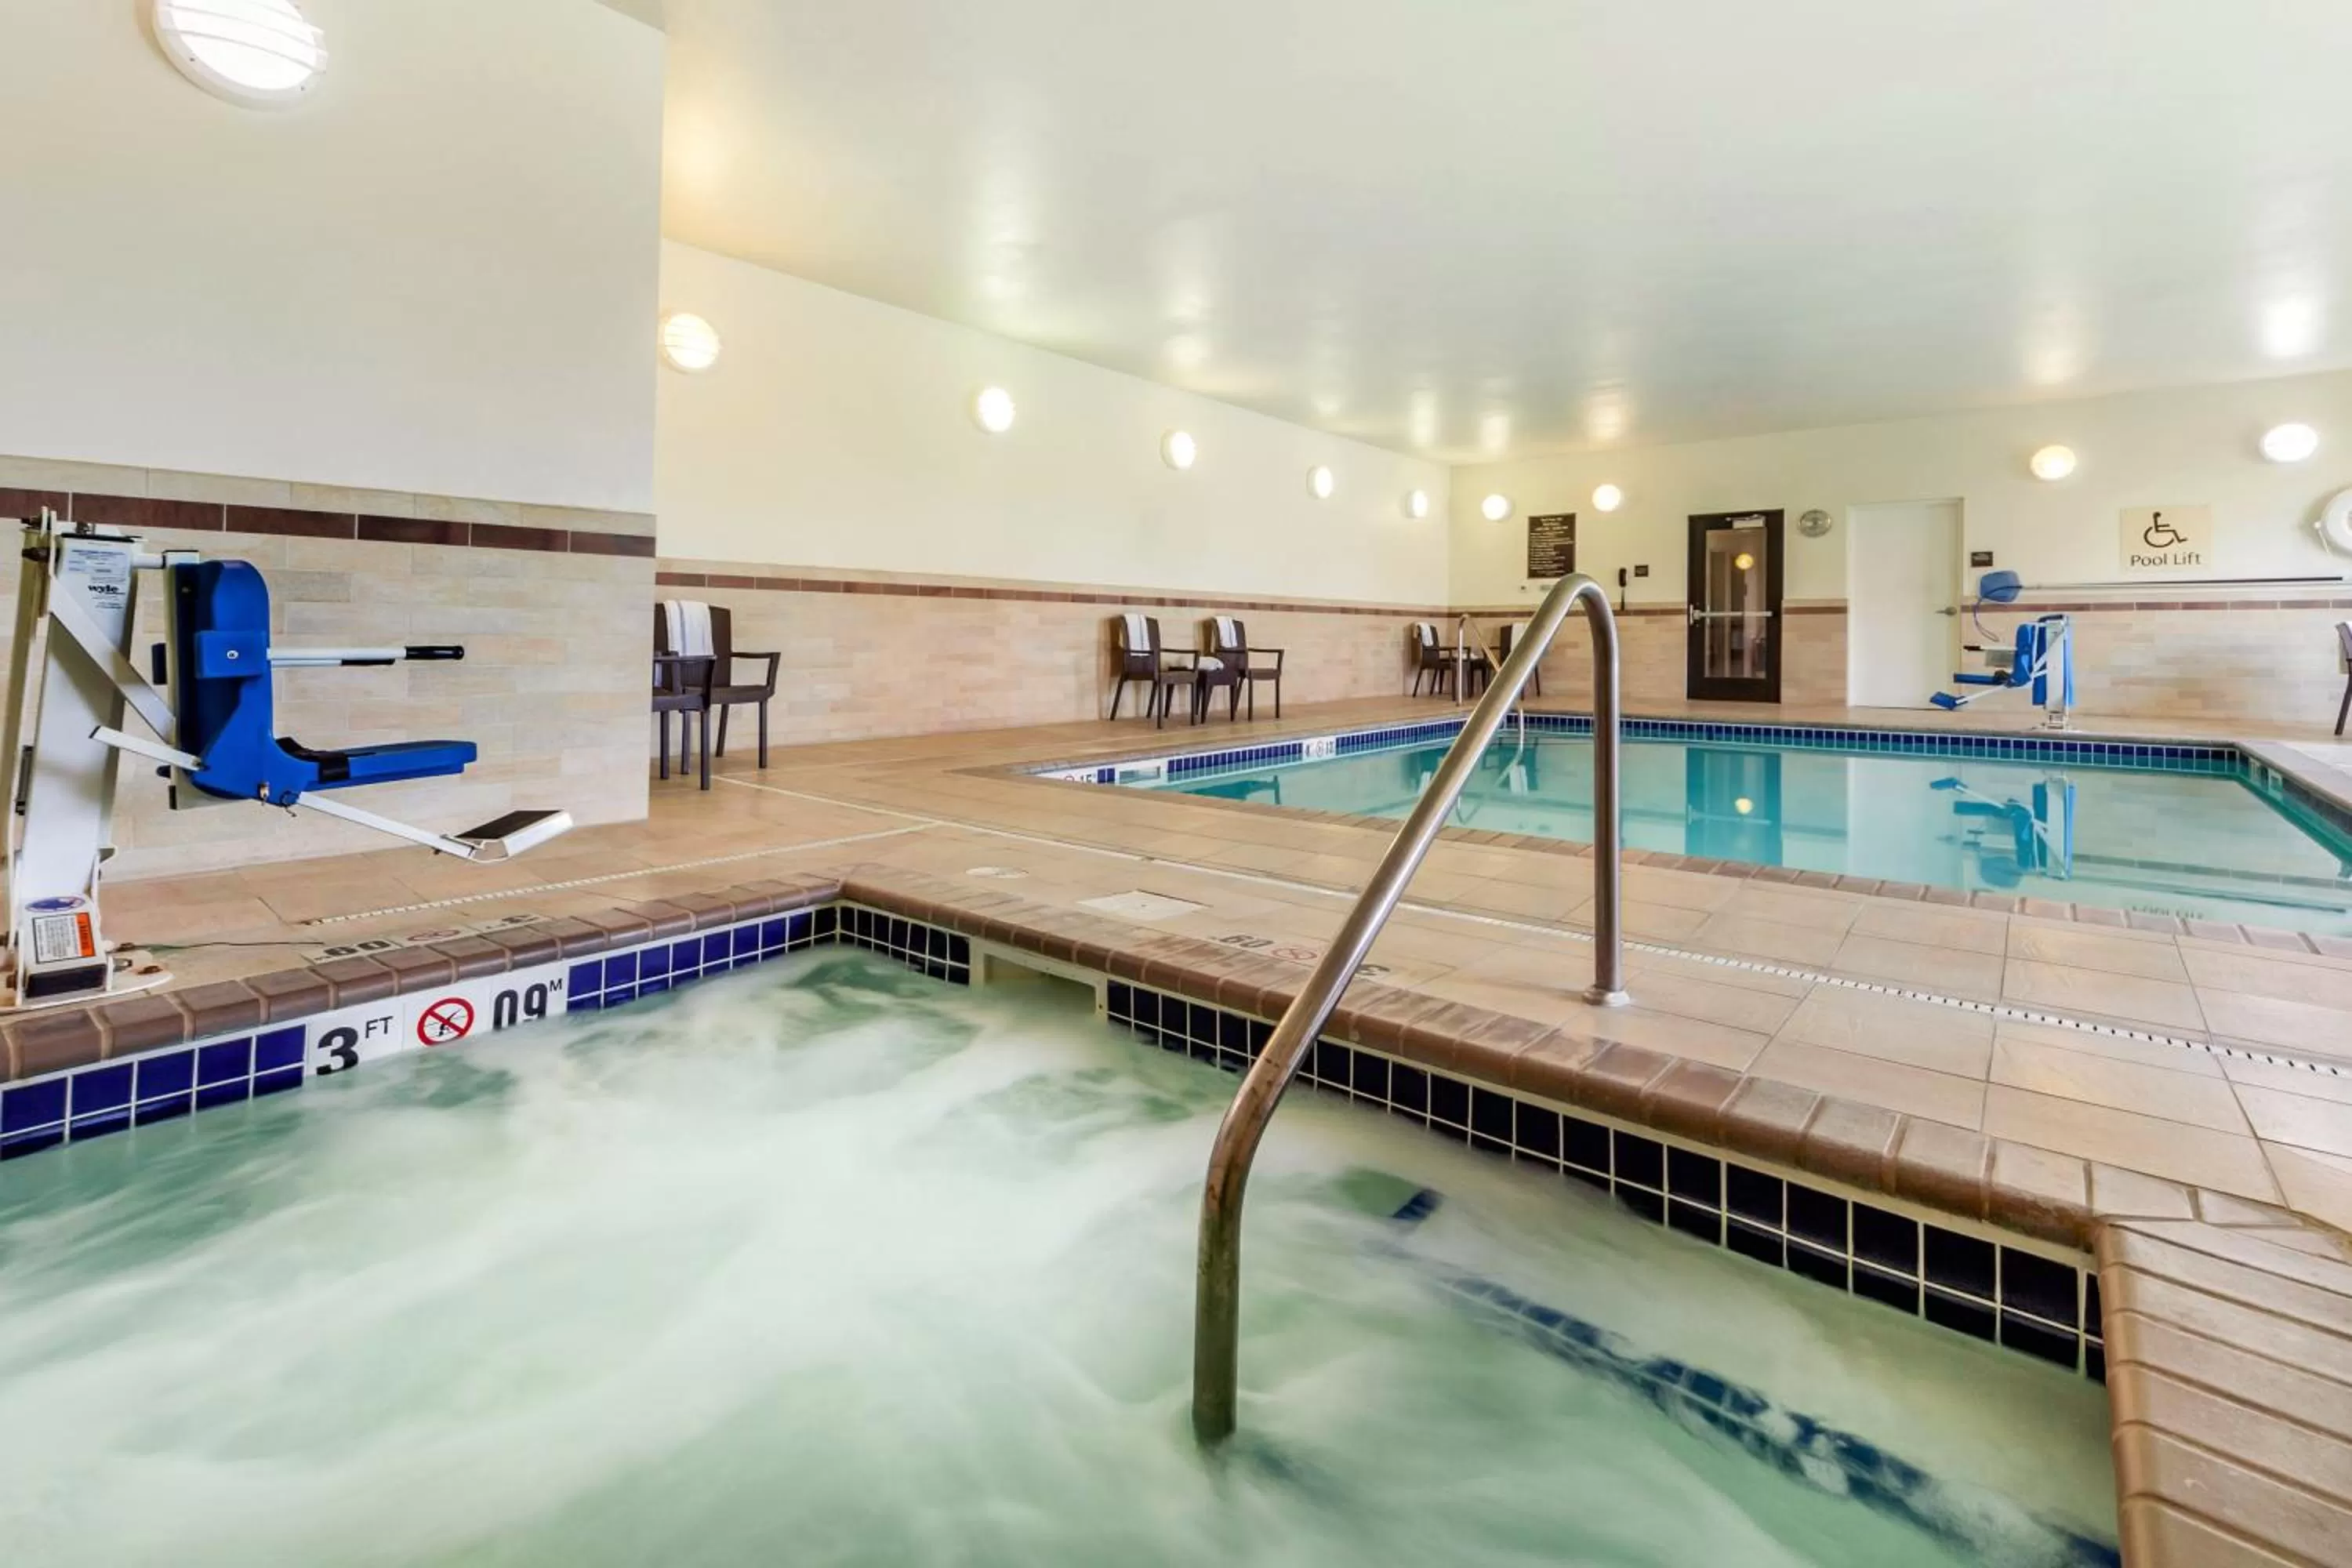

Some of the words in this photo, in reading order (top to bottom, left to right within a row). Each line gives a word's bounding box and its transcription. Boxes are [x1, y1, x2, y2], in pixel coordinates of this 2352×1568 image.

[2130, 554, 2168, 567] Pool
[2173, 552, 2201, 565] Lift
[316, 1027, 358, 1076] 3
[365, 1015, 394, 1039] FT
[493, 982, 548, 1032] 09
[550, 978, 563, 992] M
